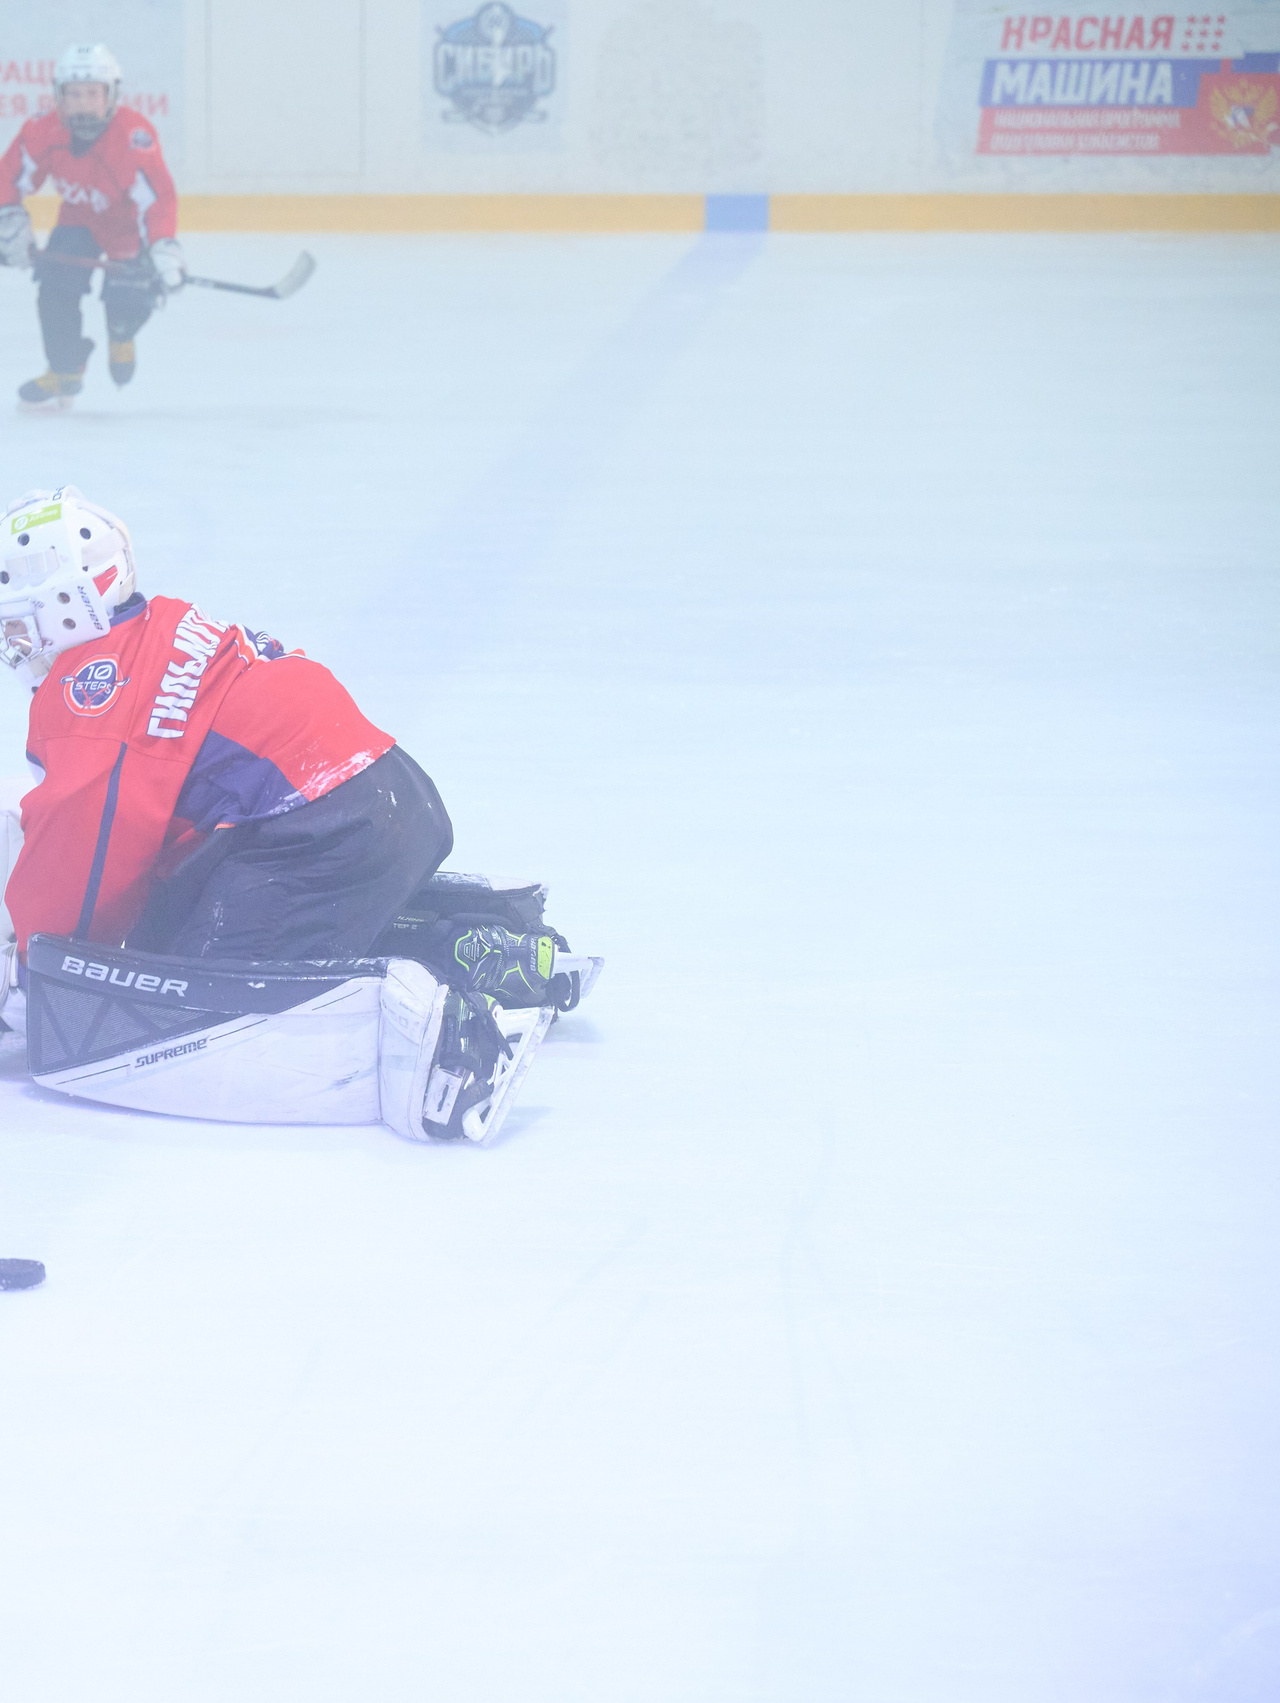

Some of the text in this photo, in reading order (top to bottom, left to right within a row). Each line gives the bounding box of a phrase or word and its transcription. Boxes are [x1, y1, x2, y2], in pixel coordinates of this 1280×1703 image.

[1000, 15, 1175, 51] КРАСНАЯ
[990, 61, 1173, 105] МАШИНА
[74, 681, 112, 694] STEPS
[87, 664, 113, 680] 10
[60, 955, 189, 998] BAUER
[134, 1036, 208, 1068] SUPREME
